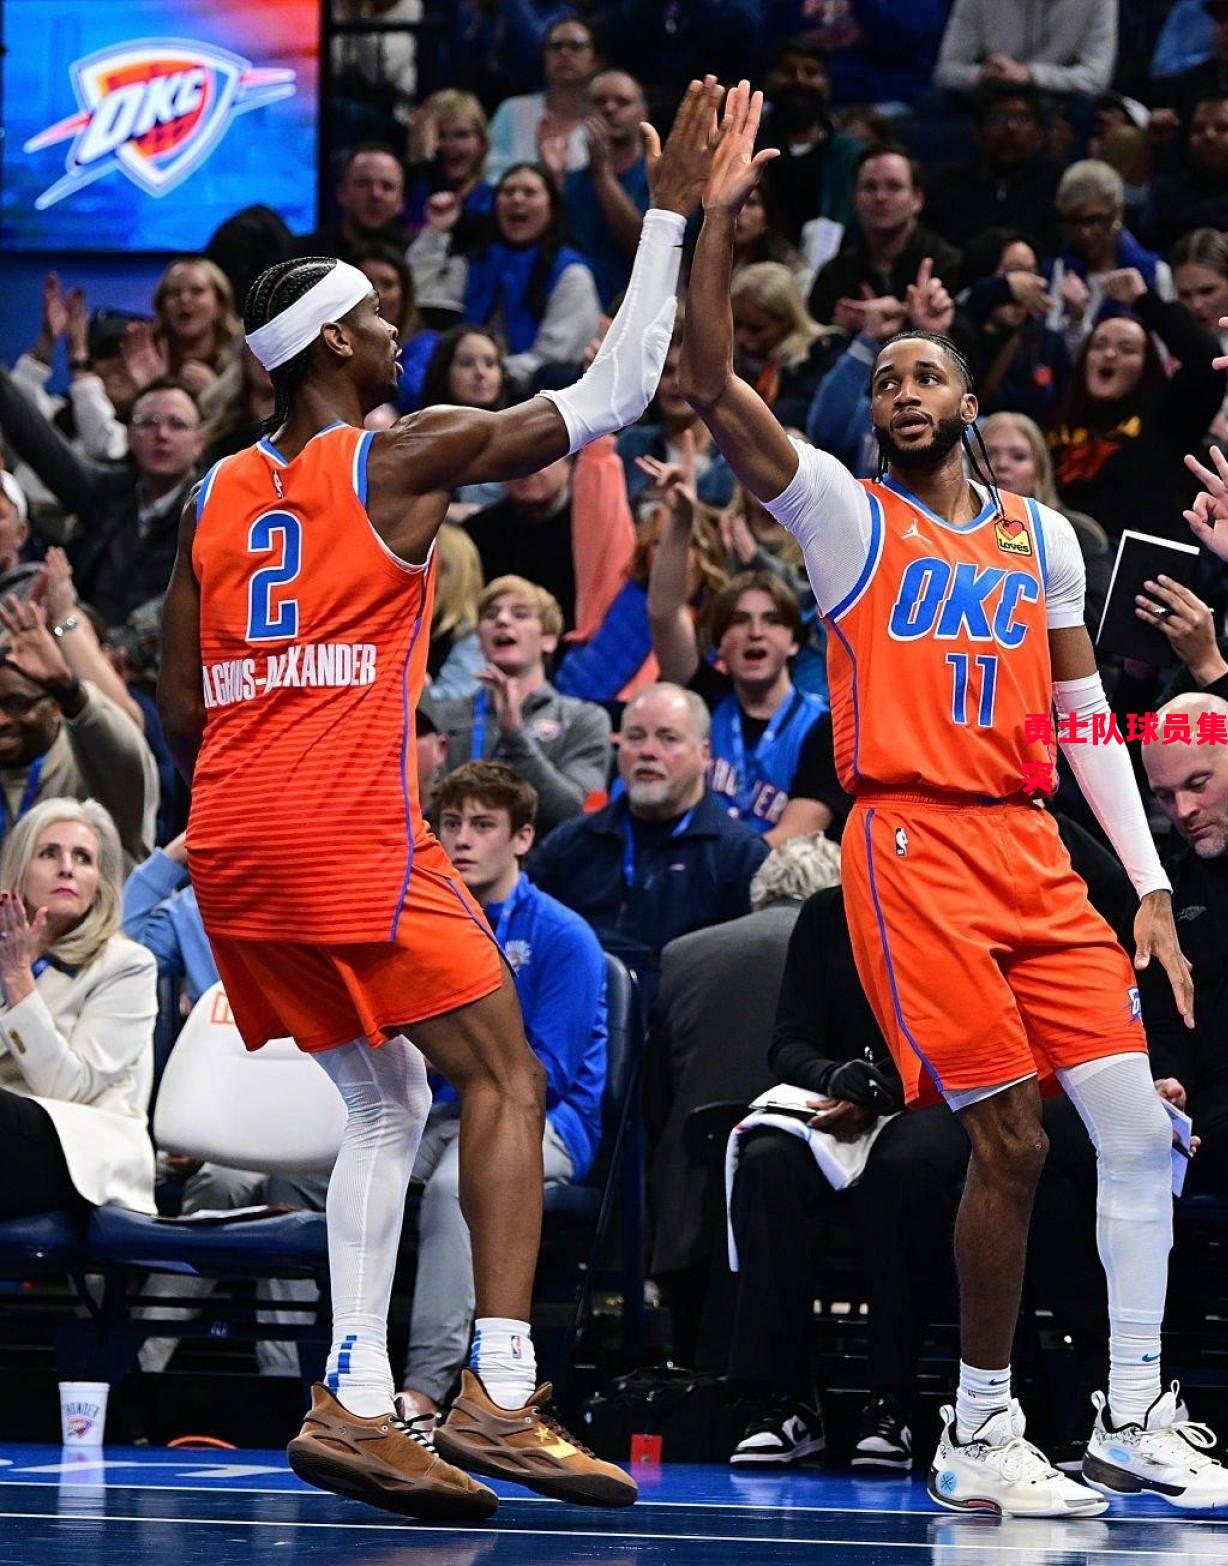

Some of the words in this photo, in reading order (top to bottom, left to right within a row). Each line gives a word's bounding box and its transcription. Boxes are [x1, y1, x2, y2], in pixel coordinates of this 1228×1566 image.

[78, 69, 206, 163] OKC
[245, 509, 303, 642] 2
[887, 556, 1040, 650] OKC
[945, 652, 999, 728] 11
